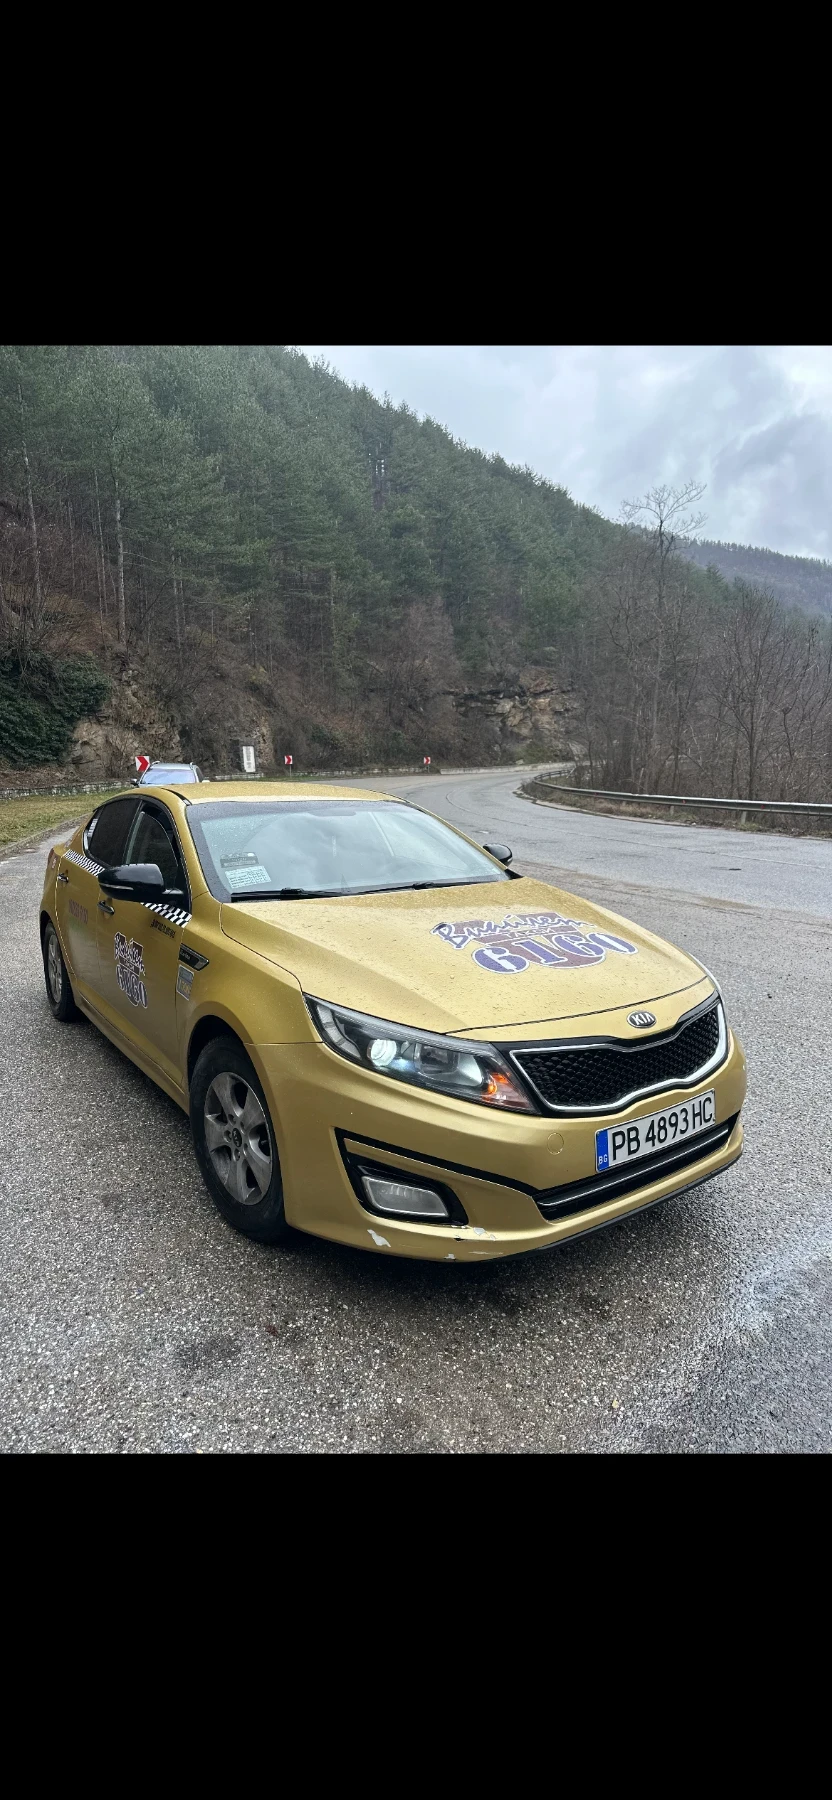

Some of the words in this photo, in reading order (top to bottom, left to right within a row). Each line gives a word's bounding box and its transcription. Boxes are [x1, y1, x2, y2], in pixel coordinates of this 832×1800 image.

[472, 932, 638, 974] 6160
[630, 1012, 655, 1026] KIA
[611, 1126, 641, 1161] PB
[645, 1107, 689, 1147] 4893
[692, 1096, 713, 1129] HC
[598, 1154, 608, 1165] BG
